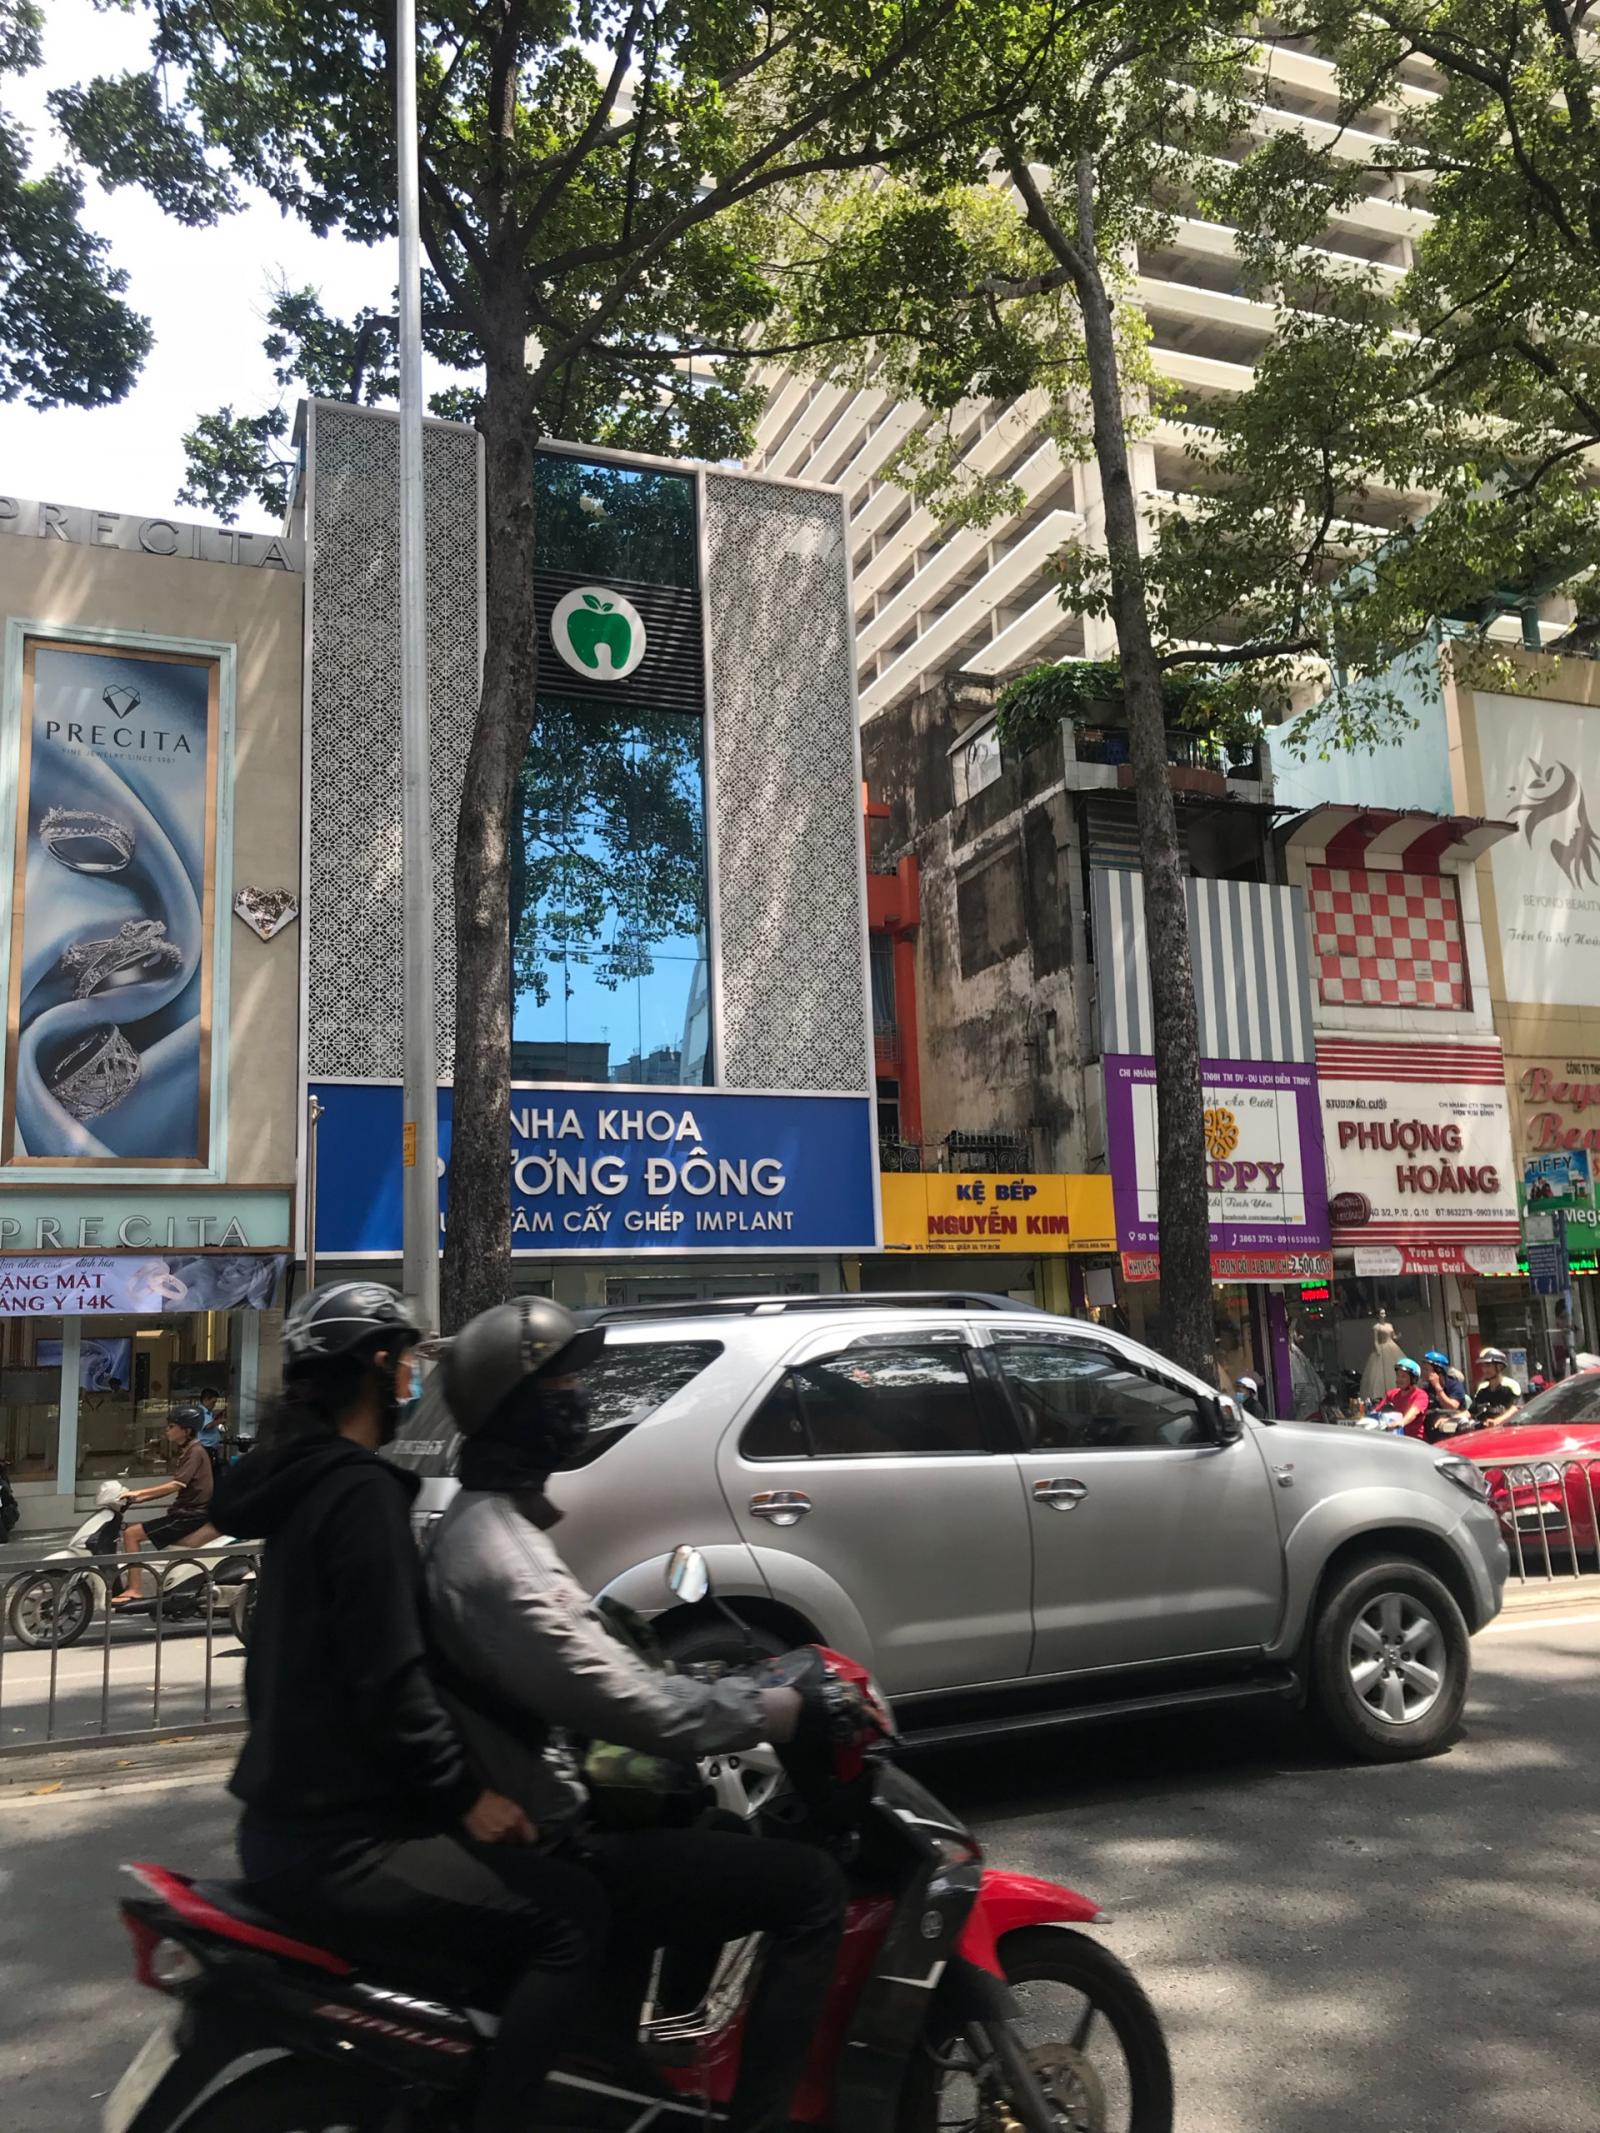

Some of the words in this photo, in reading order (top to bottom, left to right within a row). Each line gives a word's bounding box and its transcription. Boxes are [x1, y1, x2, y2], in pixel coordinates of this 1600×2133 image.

[46, 721, 191, 753] PRECITA
[127, 753, 153, 763] SINCE
[511, 1108, 584, 1140] NHA
[598, 1110, 702, 1141] KHOA
[1337, 1118, 1463, 1158] PHƯỢNG
[644, 1146, 786, 1196] ĐÔNG
[1205, 1160, 1285, 1192] PPY
[1396, 1157, 1501, 1194] HOÀNG
[1528, 1156, 1573, 1173] TIFFY
[956, 1180, 986, 1205] KỆ
[995, 1179, 1037, 1201] BẾP
[0, 1214, 249, 1249] PRECITA
[511, 1206, 554, 1232] ÂM
[563, 1203, 612, 1232] CẤY
[624, 1204, 685, 1233] GHÉP
[696, 1210, 794, 1232] IMPLANT
[928, 1206, 1017, 1235] NGUYỄN
[1026, 1215, 1069, 1235] KIM
[1406, 1262, 1439, 1273] Album
[1442, 1261, 1466, 1273] Cưới
[1408, 1247, 1435, 1259] Trọn
[1438, 1246, 1455, 1258] Gói
[0, 1272, 49, 1294] ẶNG
[56, 1271, 105, 1292] MẶT
[76, 1294, 116, 1310] 14K
